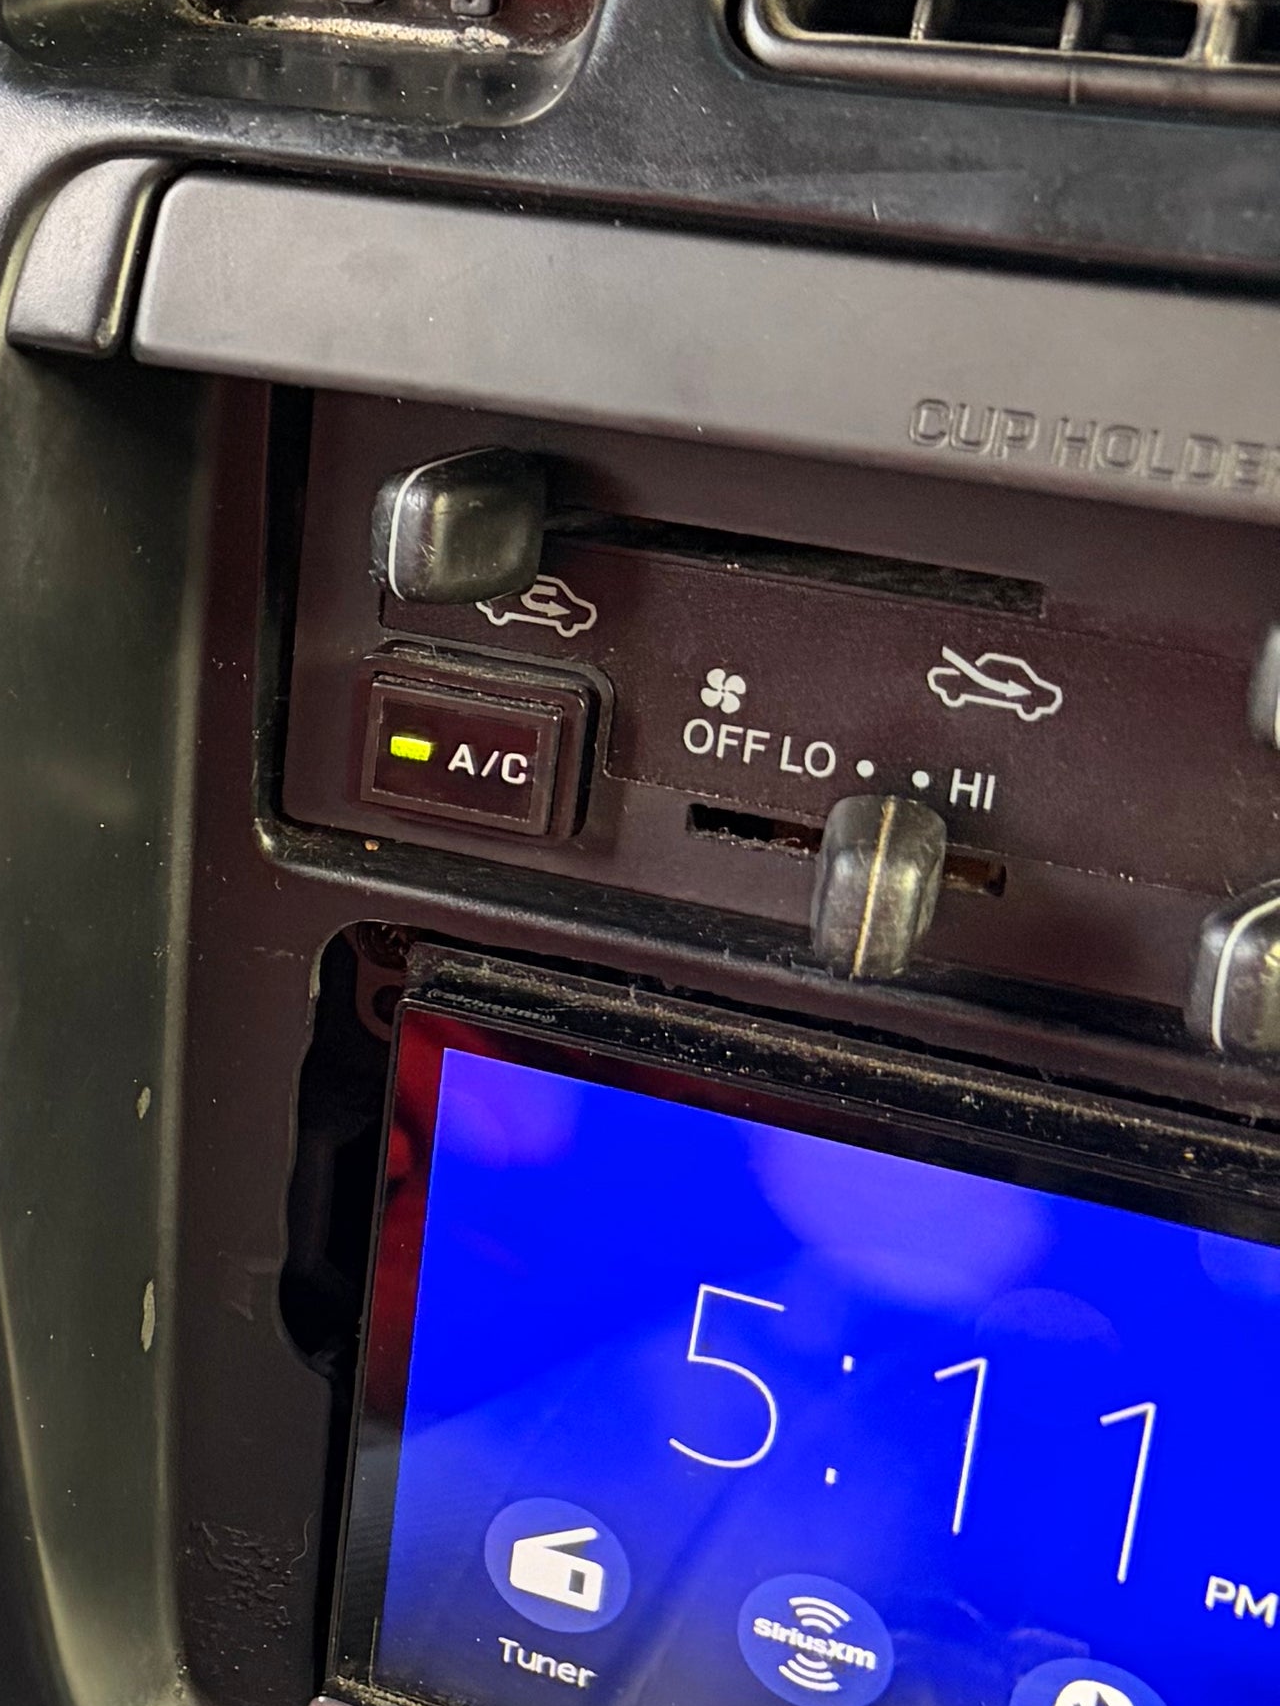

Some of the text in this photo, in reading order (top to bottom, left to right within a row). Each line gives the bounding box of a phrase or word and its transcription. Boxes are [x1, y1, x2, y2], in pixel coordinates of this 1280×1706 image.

[908, 398, 1280, 490] CUP HOLDE
[448, 742, 529, 786] A/C
[682, 718, 996, 811] OFF LO HI
[668, 1282, 1279, 1630] 5:11 PM
[497, 1634, 597, 1691] Tuner
